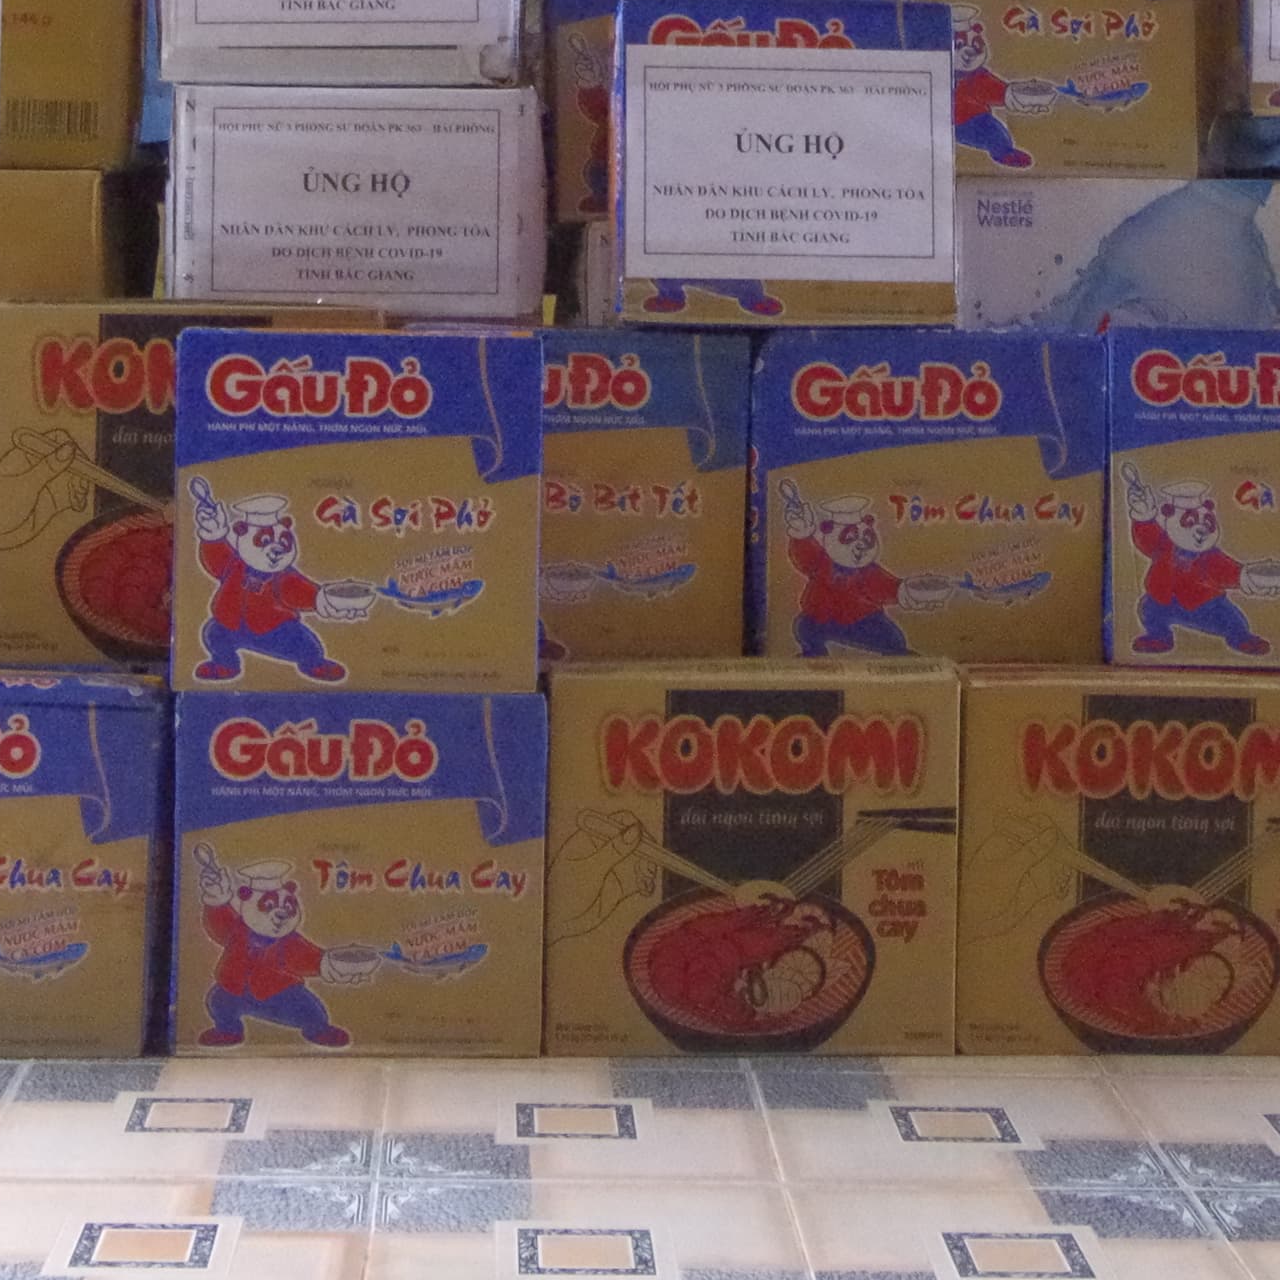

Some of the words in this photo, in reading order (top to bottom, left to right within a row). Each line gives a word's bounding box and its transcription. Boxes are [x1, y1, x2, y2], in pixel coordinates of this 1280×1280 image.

[1003, 7, 1040, 34] Gà
[735, 126, 794, 154] ỦNG
[803, 130, 844, 159] HỘ
[302, 166, 361, 192] ỦNG
[369, 169, 410, 198] HỘ
[977, 198, 1033, 215] Nestlé
[977, 214, 1033, 228] Waters
[316, 495, 358, 527] Gà
[889, 494, 945, 523] Tôm
[955, 493, 1025, 524] Chua
[1034, 493, 1085, 527] Cay
[1235, 480, 1274, 510] Gà
[602, 715, 926, 795] KOKOMI
[72, 858, 128, 893] Cay
[313, 858, 373, 890] Tôm
[384, 858, 461, 891] Chua
[470, 859, 526, 897] Cay
